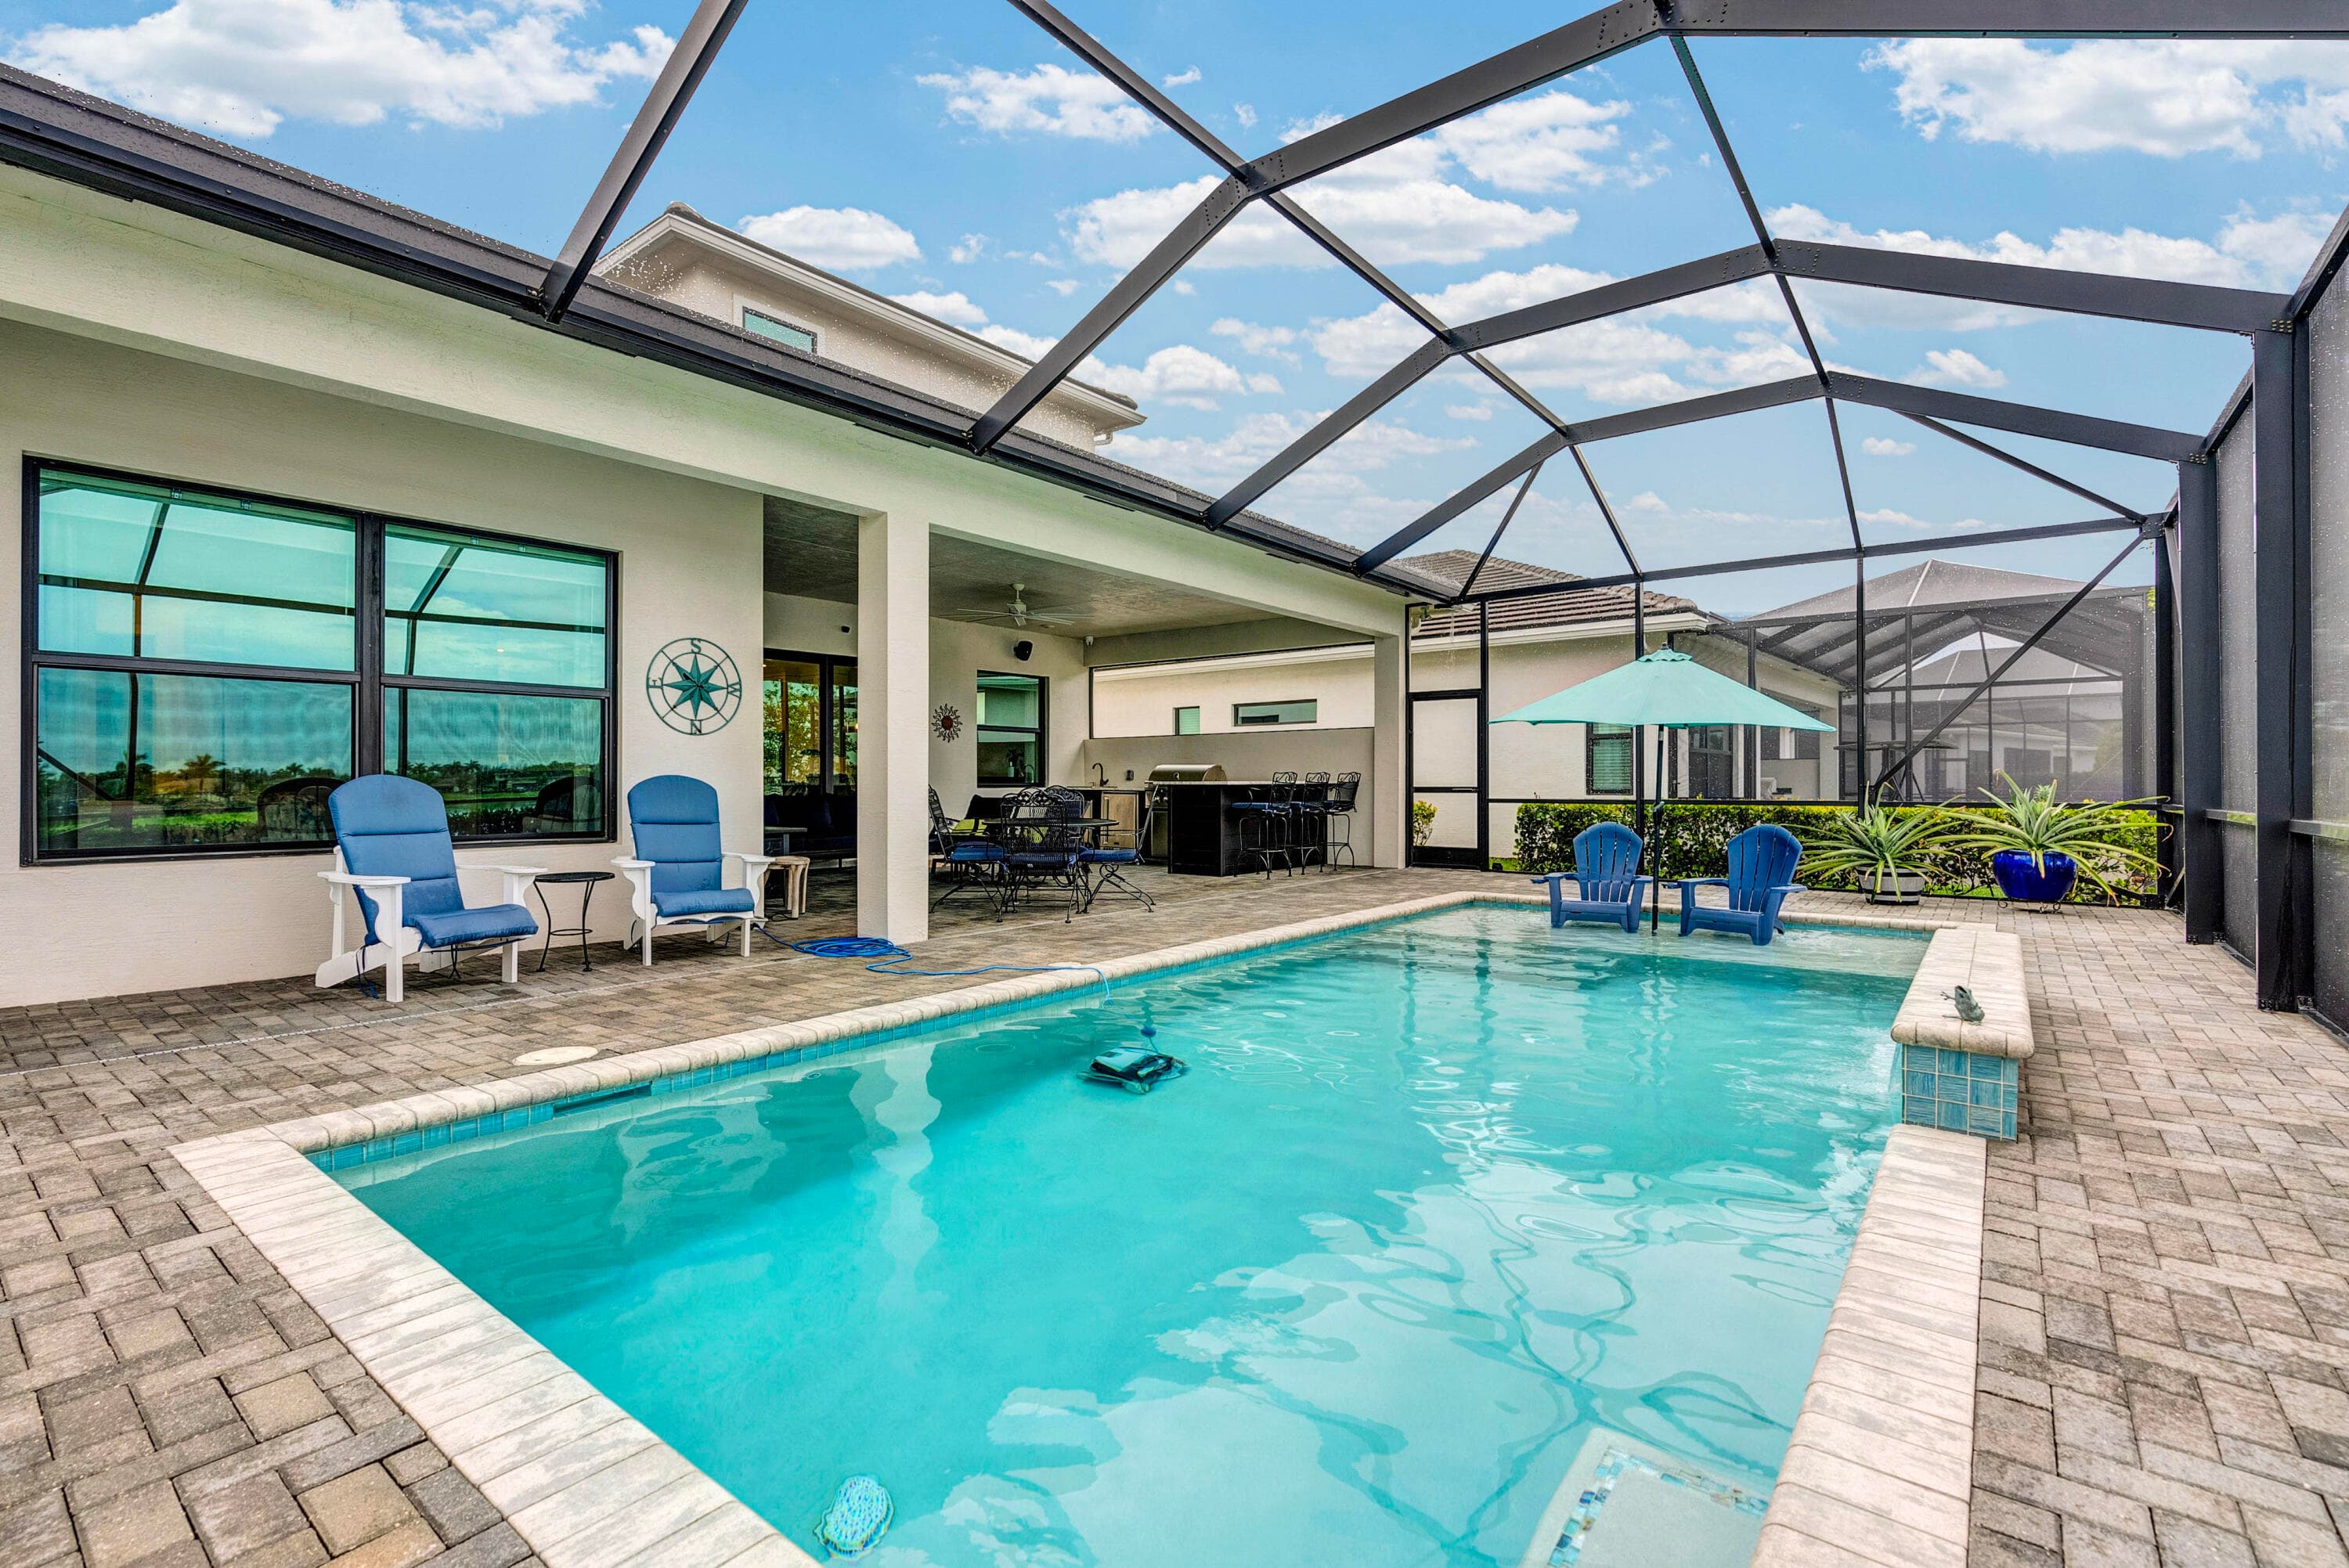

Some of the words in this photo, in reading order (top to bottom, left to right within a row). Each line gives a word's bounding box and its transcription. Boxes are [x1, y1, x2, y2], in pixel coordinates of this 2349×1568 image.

[690, 638, 702, 653] S
[647, 677, 663, 689] E
[727, 681, 742, 698] W
[690, 719, 702, 734] N
